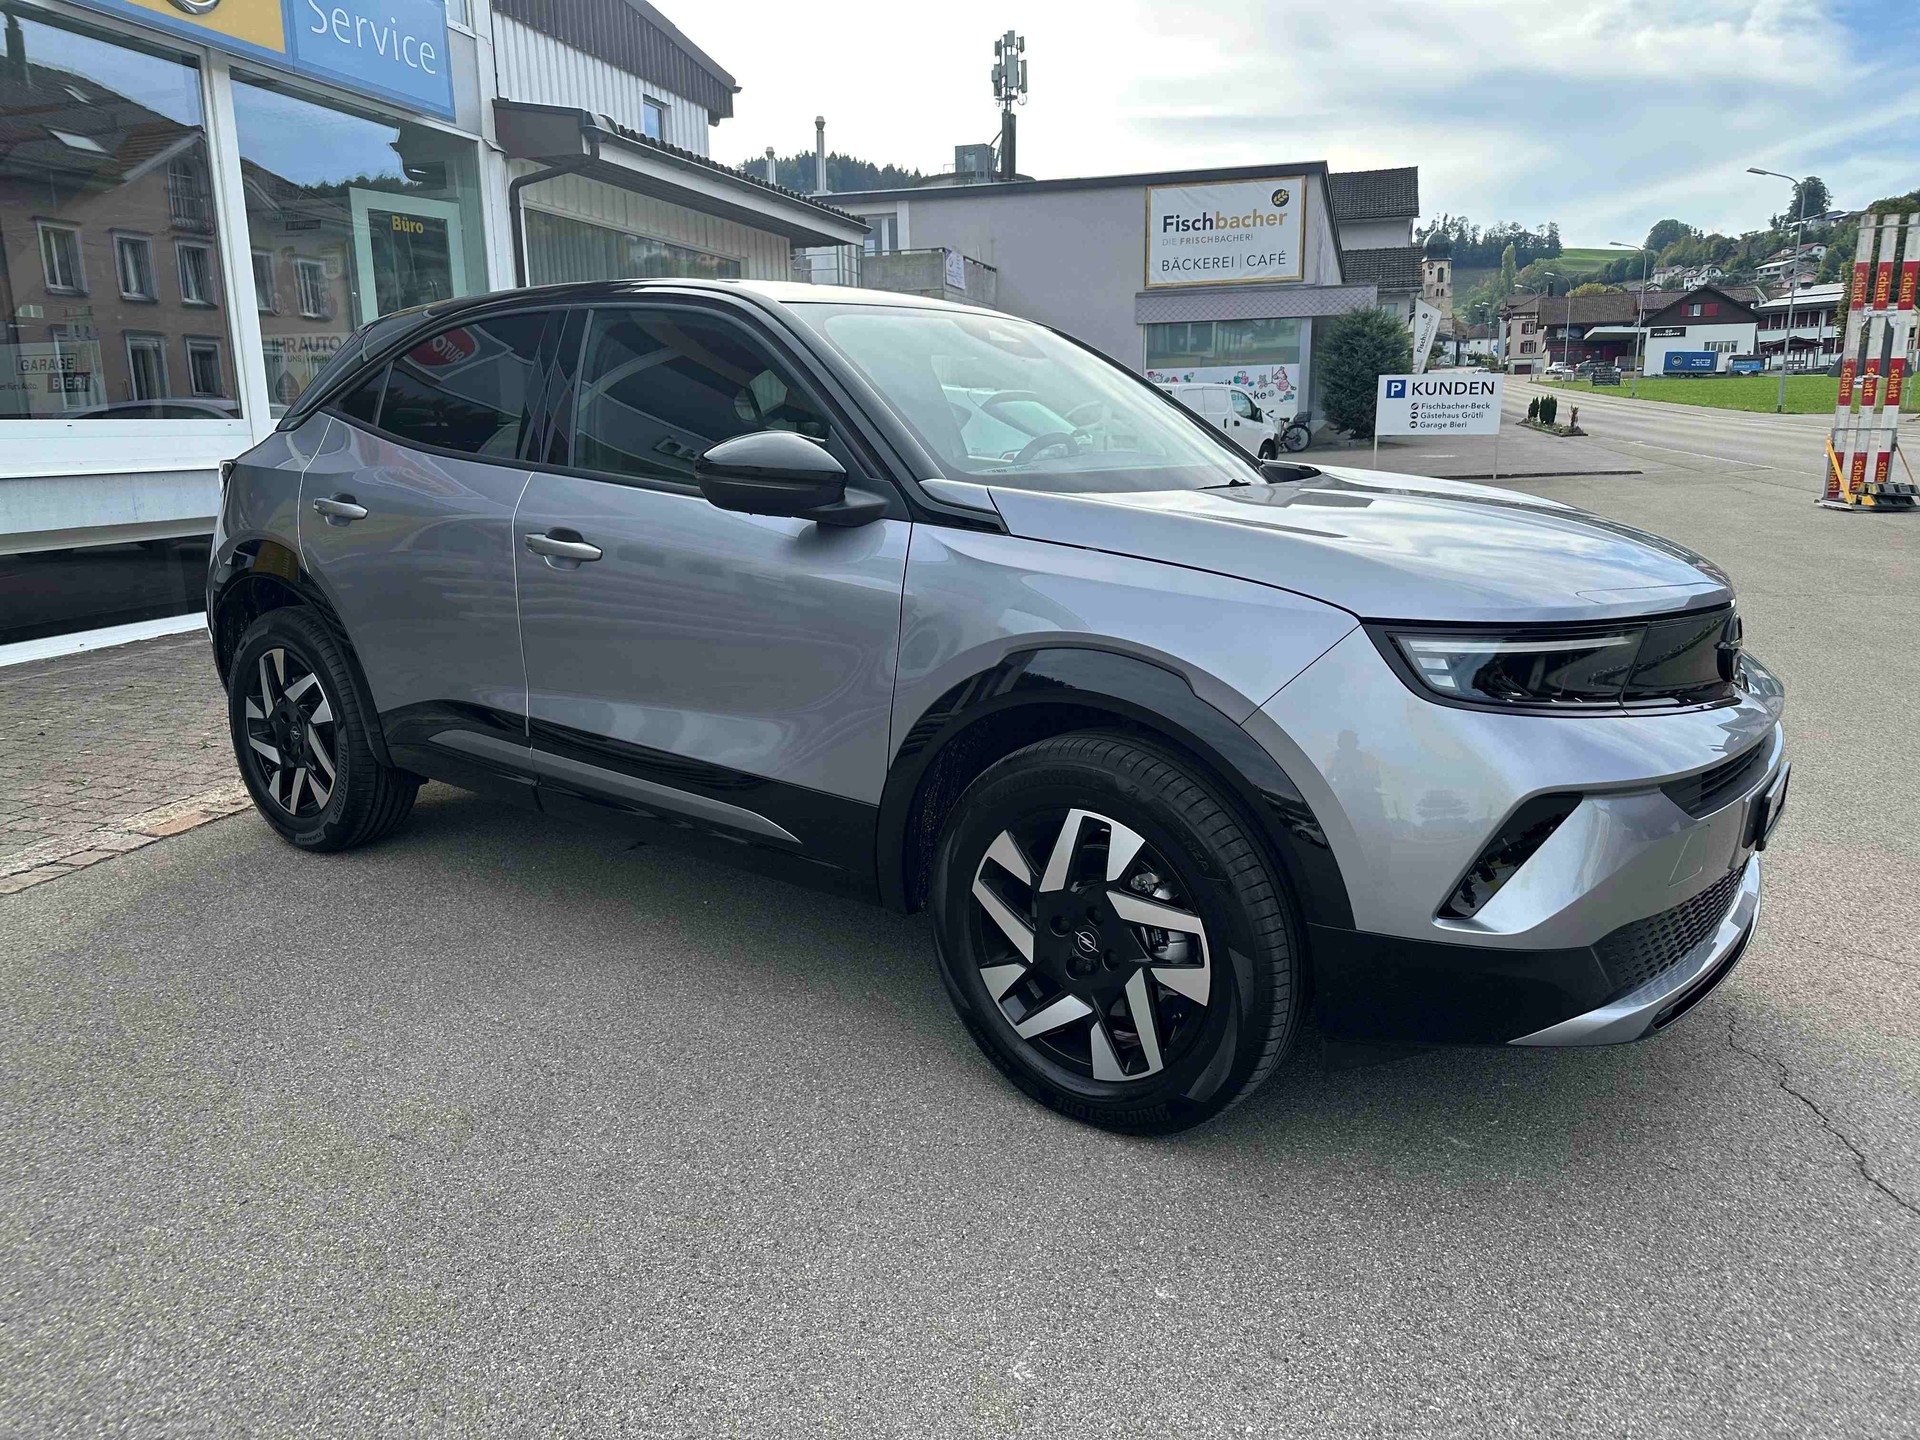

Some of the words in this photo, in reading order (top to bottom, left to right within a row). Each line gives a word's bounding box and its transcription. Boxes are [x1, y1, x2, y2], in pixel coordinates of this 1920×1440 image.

[308, 0, 436, 74] Service
[391, 215, 424, 234] Büro
[1162, 208, 1288, 233] Fischbacher
[1162, 237, 1177, 247] DIE
[1161, 256, 1235, 272] BÄCKEREI
[1246, 250, 1287, 267] CAFÉ
[1852, 272, 1866, 303] schatt
[1876, 271, 1889, 302] schatt
[1900, 272, 1914, 303] schatt
[271, 337, 297, 353] IHR
[298, 335, 342, 353] AUTO
[20, 357, 74, 372] GARAGE
[1390, 382, 1402, 396] P
[1411, 381, 1495, 396] KUNDEN
[1840, 367, 1853, 397] schatt
[1888, 368, 1901, 399] schatt
[1420, 411, 1460, 419] Gästehaus
[1461, 411, 1484, 419] Grütli
[1421, 402, 1491, 410] Fischbacher-Beck
[1419, 422, 1448, 430] Garage
[1851, 460, 1864, 489] schatt
